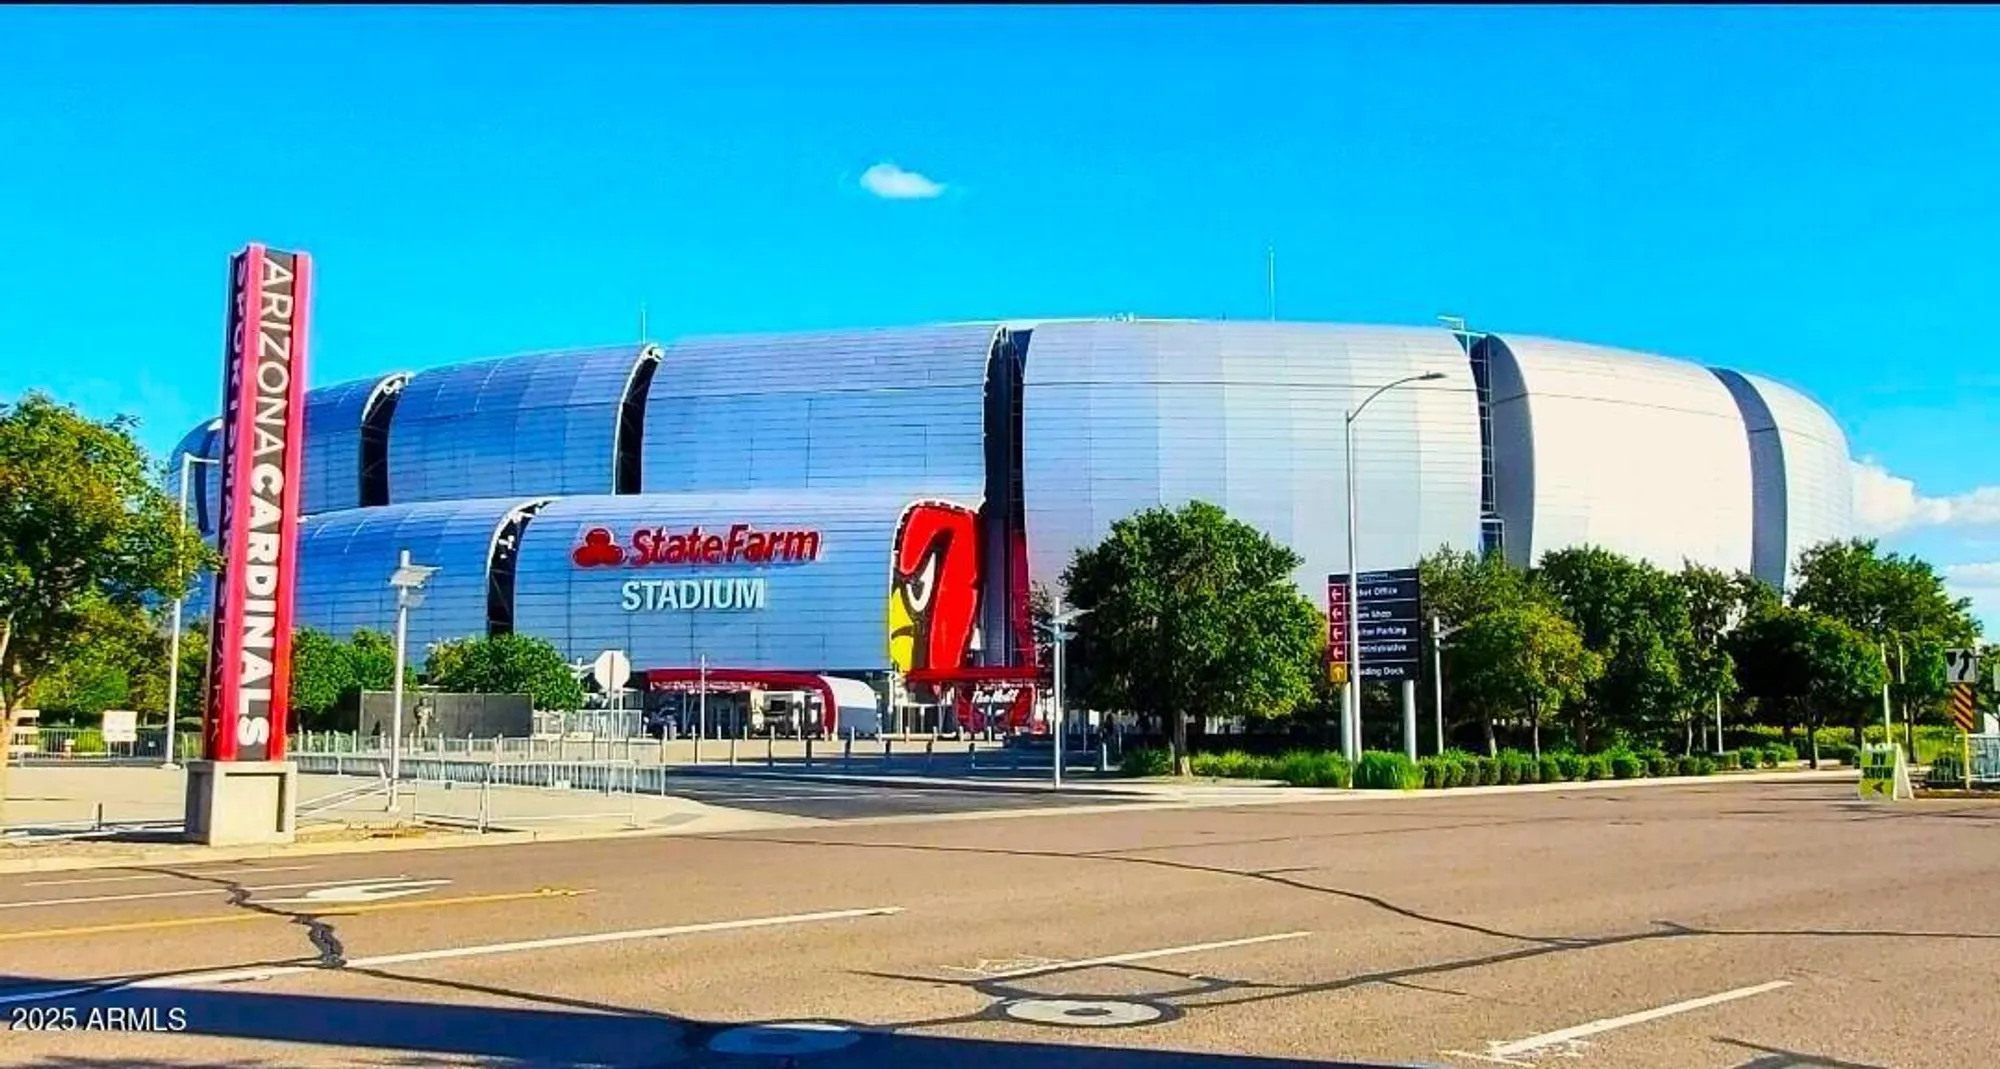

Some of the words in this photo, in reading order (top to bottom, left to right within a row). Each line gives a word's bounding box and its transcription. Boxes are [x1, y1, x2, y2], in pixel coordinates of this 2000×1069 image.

[253, 257, 294, 457] ARIZONA
[237, 462, 285, 746] CARDINALS
[622, 578, 766, 611] STADIUM
[1376, 626, 1407, 636] Parking
[1384, 667, 1405, 675] Dock
